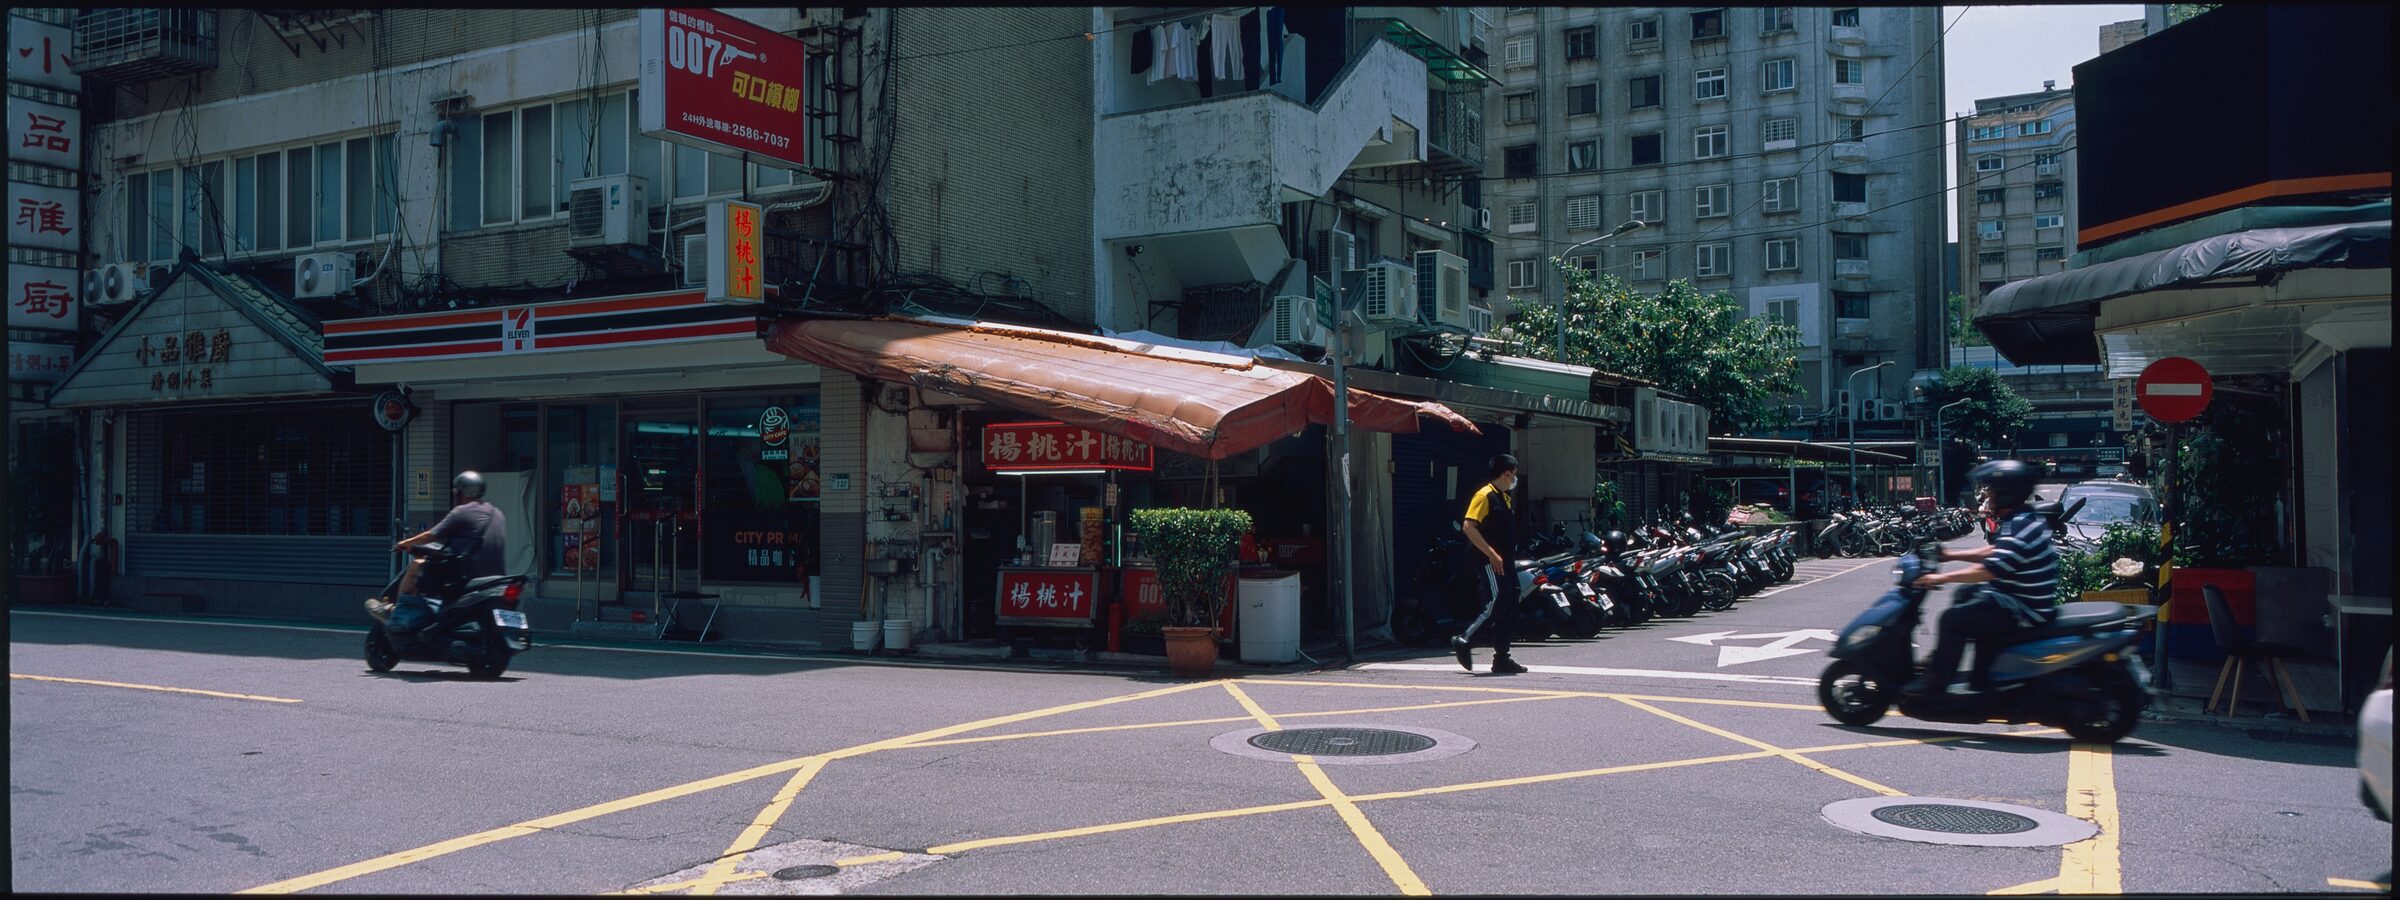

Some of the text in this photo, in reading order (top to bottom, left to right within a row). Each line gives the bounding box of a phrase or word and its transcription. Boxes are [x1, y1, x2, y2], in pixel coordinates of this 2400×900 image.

[669, 25, 722, 79] 007
[732, 70, 800, 113] 可口檳榔
[732, 123, 790, 149] 2586-7037
[735, 210, 756, 297] 楊桃汁
[989, 430, 1098, 462] 楊桃汁
[1107, 434, 1148, 463] 楊桃汁
[735, 531, 764, 544] CITY
[1011, 581, 1083, 612] 楊桃汁
